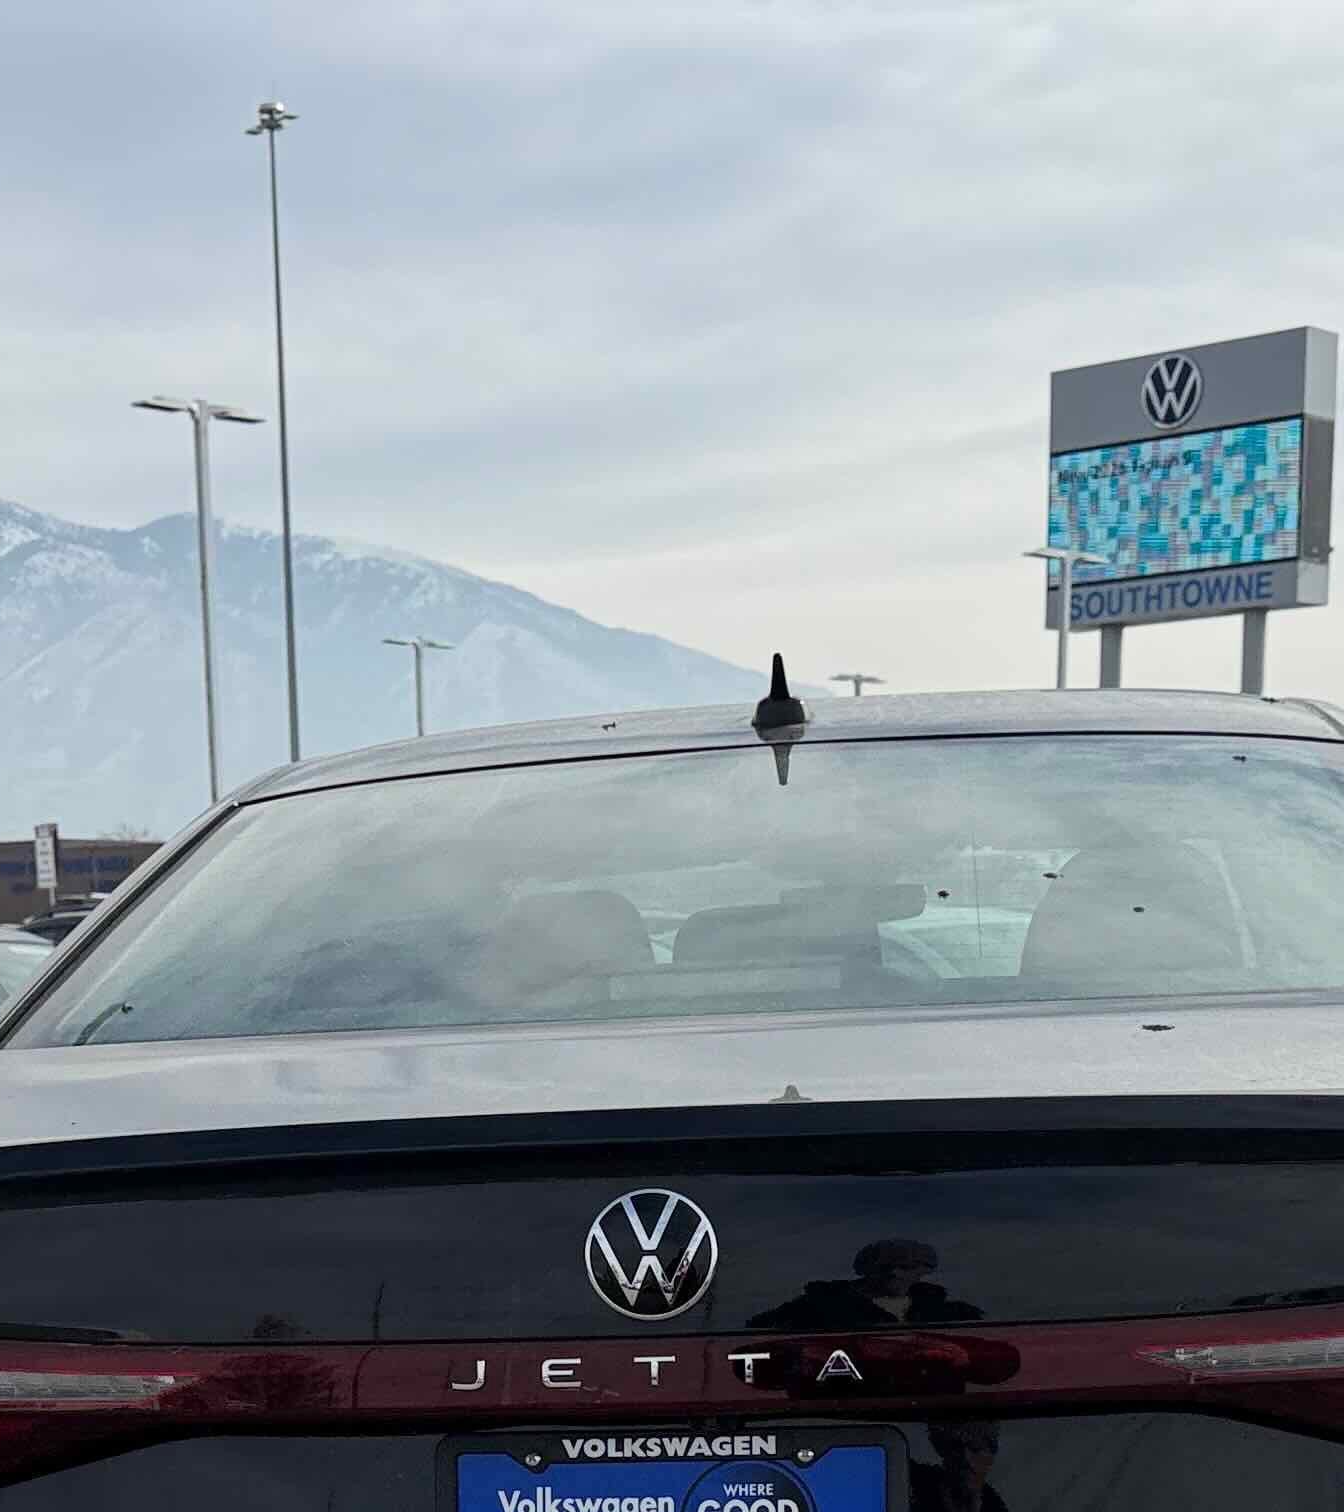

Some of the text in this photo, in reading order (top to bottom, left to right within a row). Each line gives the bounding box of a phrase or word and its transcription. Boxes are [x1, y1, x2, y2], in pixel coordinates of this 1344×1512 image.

[1143, 354, 1201, 428] VW
[1071, 571, 1274, 621] SOUTHTOWNE
[585, 1188, 718, 1320] VW
[451, 1349, 864, 1391] JETTA
[562, 1435, 777, 1459] VOLKSWAGEN
[723, 1483, 775, 1497] WHERE
